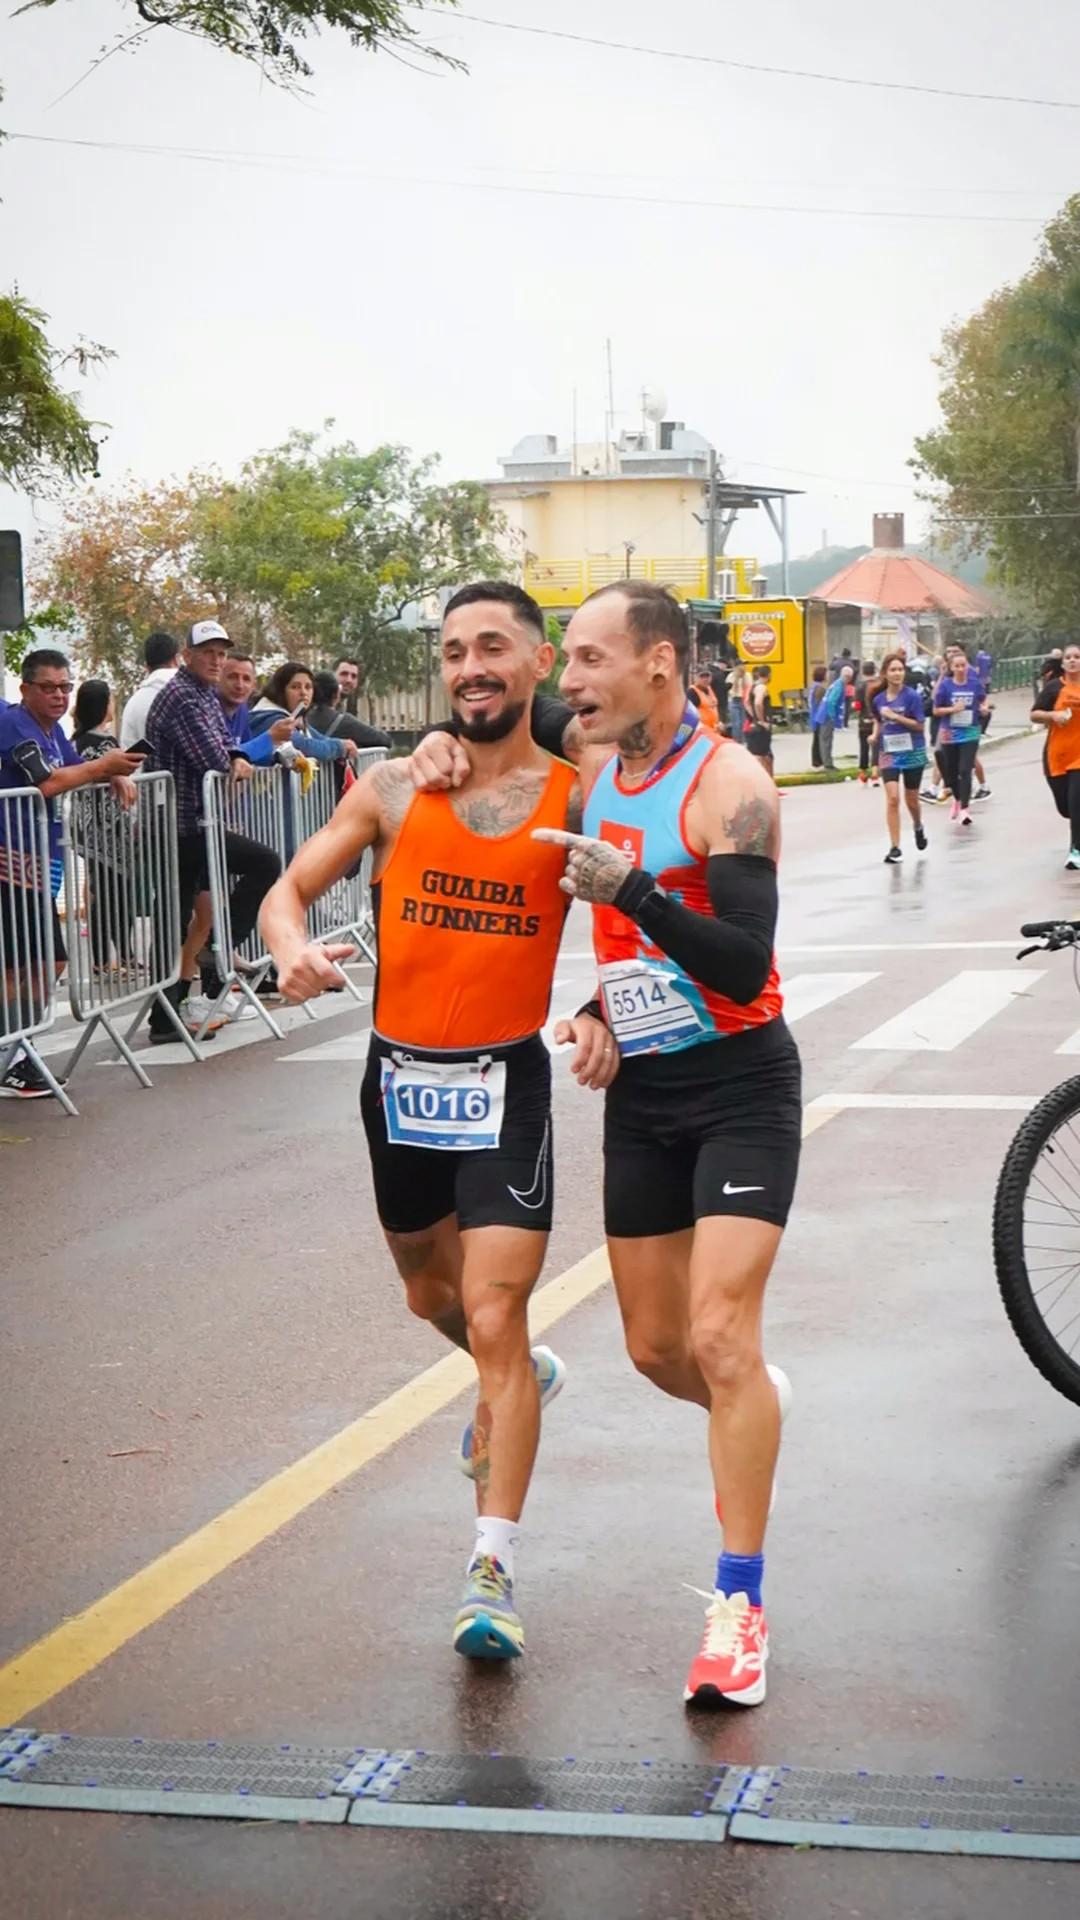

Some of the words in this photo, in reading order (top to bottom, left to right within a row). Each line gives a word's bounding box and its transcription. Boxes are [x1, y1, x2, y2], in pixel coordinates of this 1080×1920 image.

[422, 869, 526, 907] GUAIBA
[400, 897, 540, 936] RUNNERS
[613, 981, 667, 1016] 5514
[400, 1086, 486, 1120] 1016
